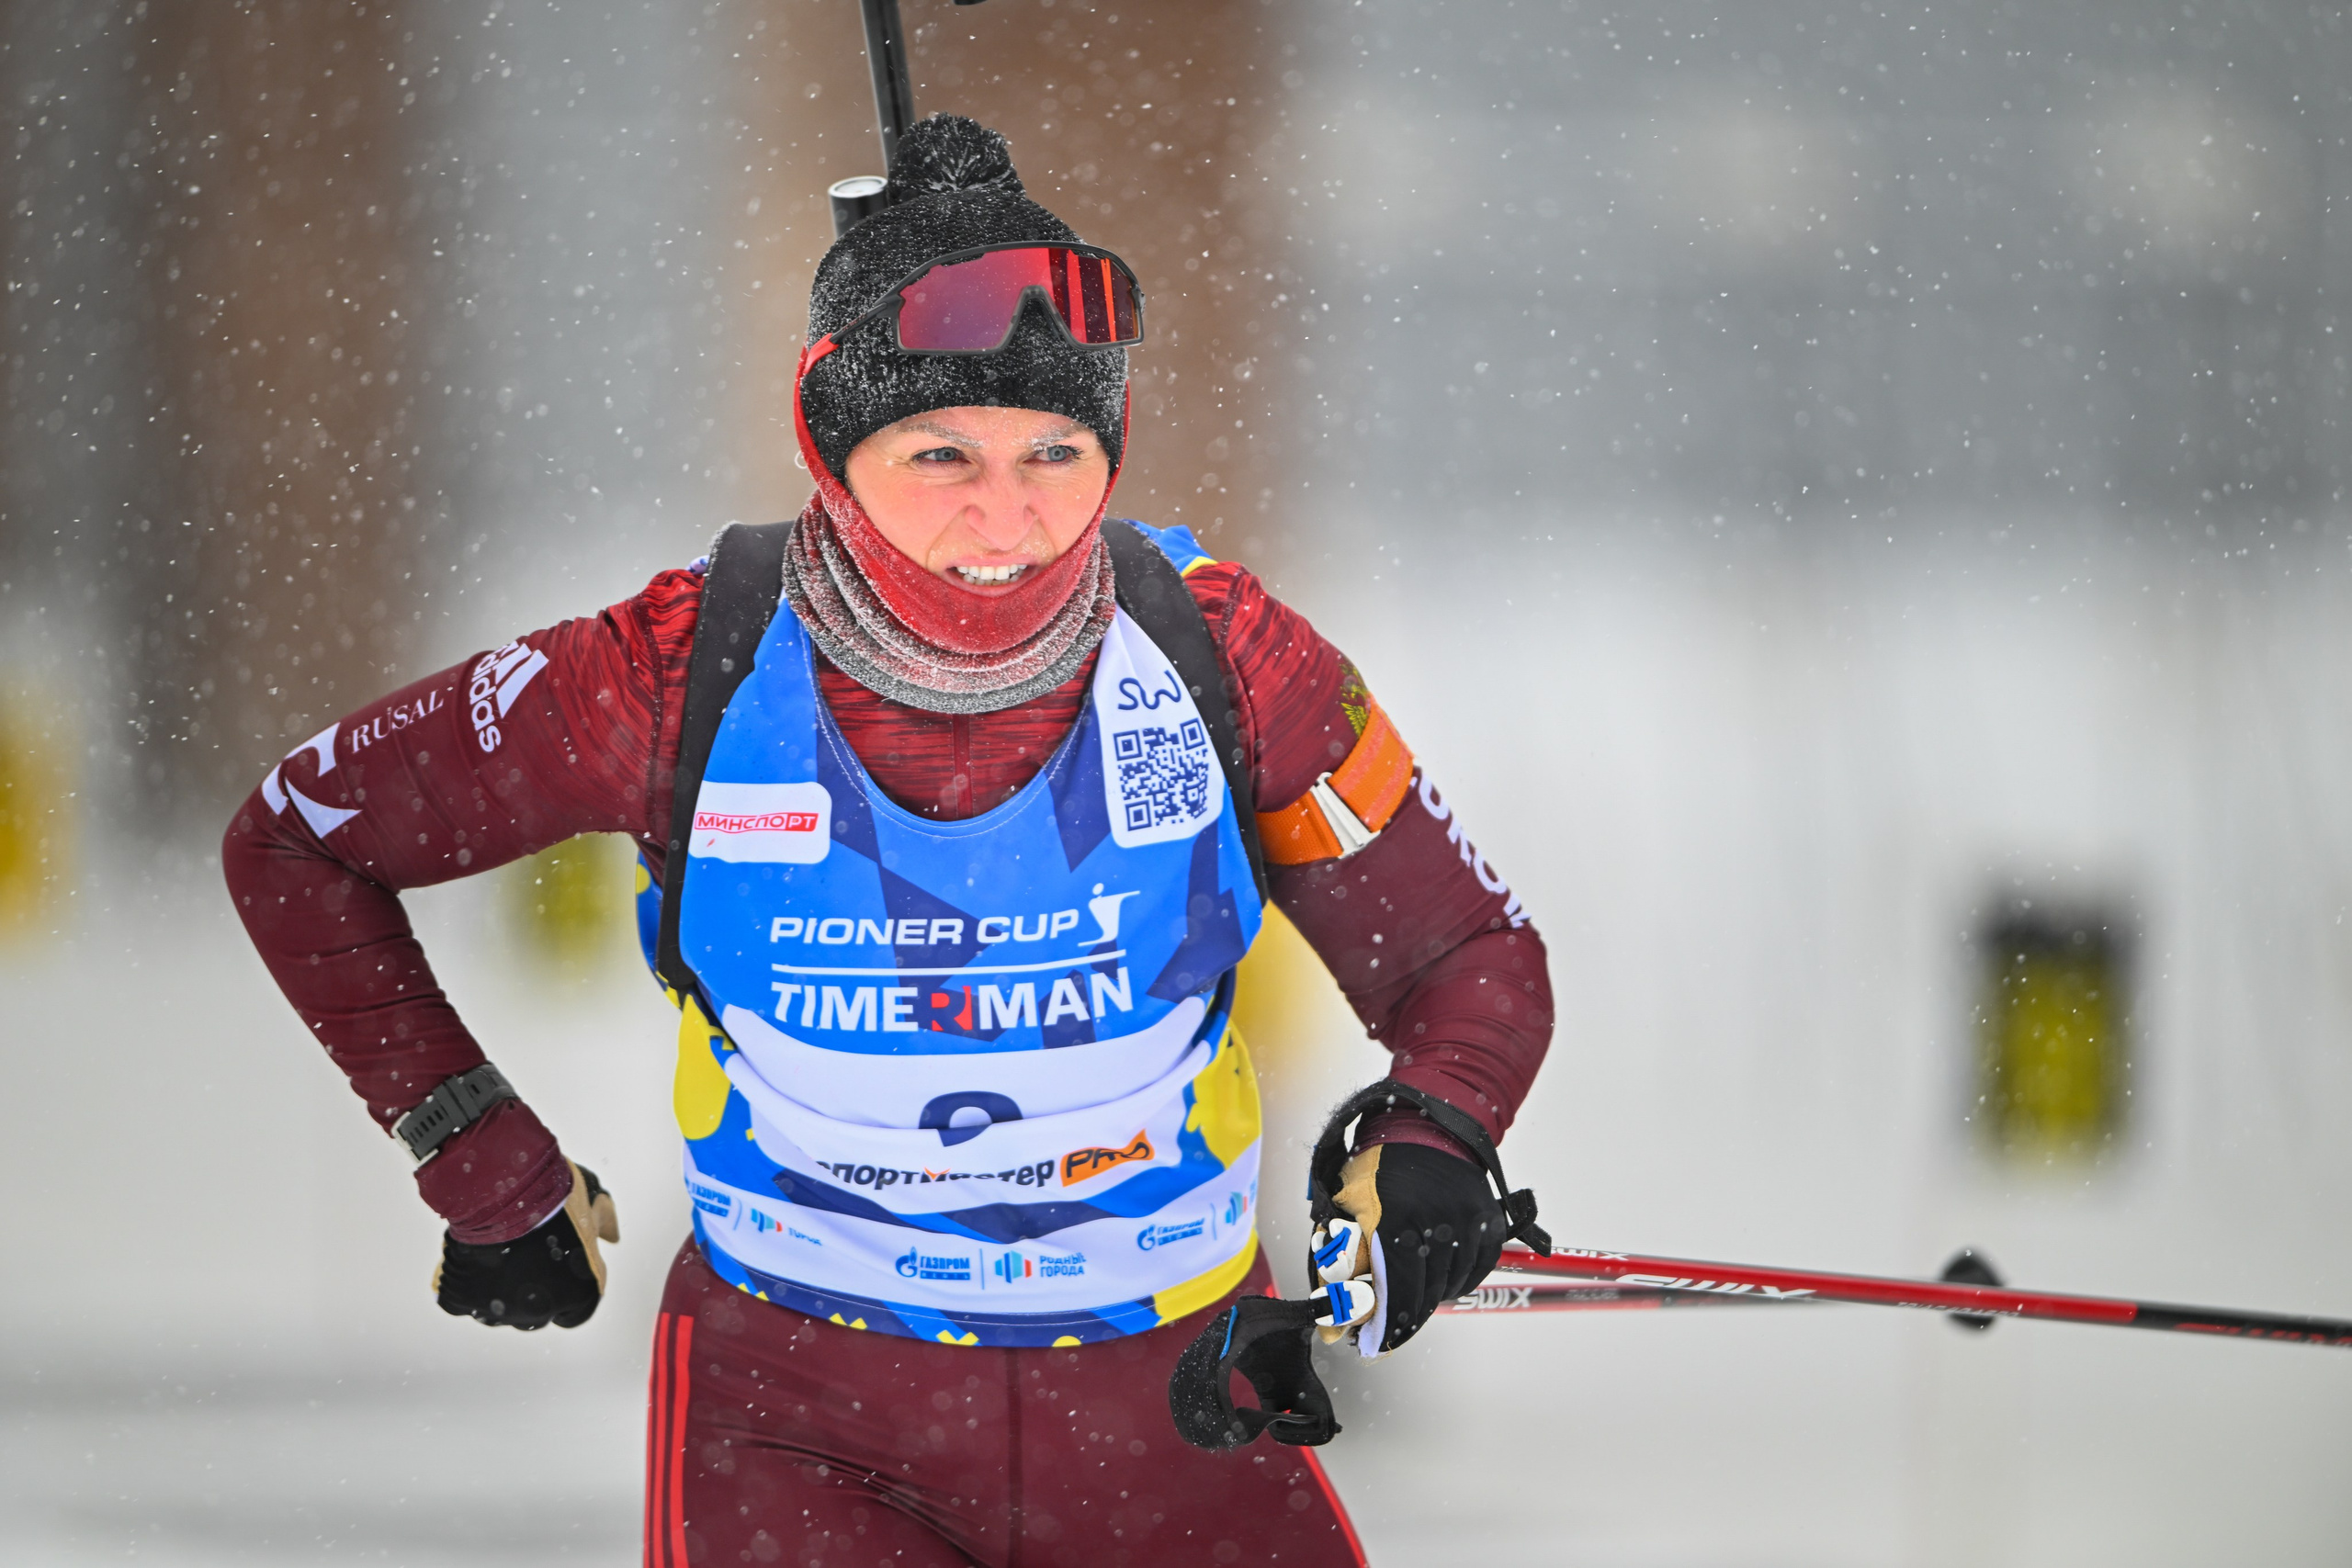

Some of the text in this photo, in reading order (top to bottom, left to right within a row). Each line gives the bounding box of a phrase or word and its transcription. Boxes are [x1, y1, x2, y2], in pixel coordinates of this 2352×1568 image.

[469, 645, 507, 752] didas
[352, 690, 444, 753] RUSAL
[696, 814, 817, 831] МИНСПОРТ
[770, 908, 1080, 945] PIONER CUP
[920, 1256, 970, 1269] ГАЗПРОМ
[1039, 1265, 1085, 1278] ГОРОДА
[1451, 1287, 1532, 1311] SWIX
